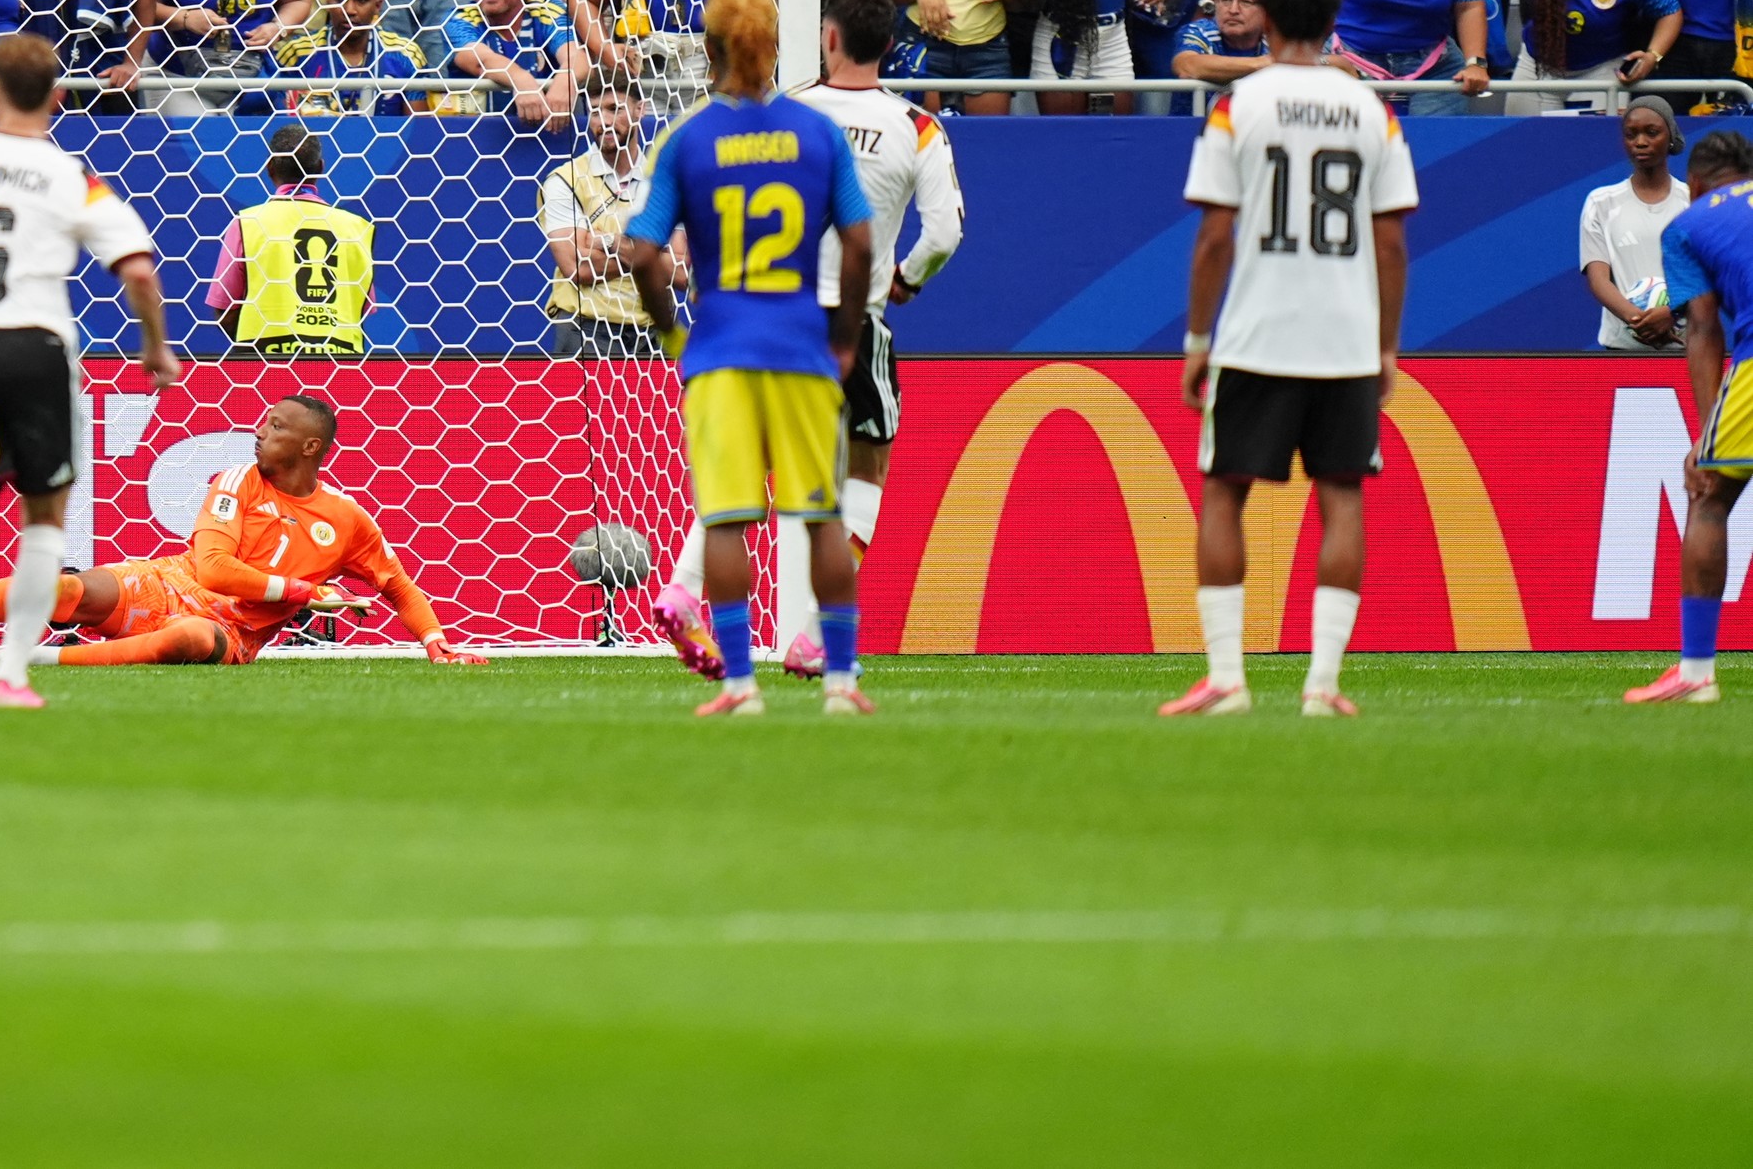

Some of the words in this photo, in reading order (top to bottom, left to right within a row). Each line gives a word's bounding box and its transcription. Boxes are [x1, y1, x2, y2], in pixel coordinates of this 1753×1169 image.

[1276, 99, 1361, 129] BROWN
[1260, 144, 1363, 257] 18
[711, 181, 806, 293] 12
[306, 288, 329, 298] FIFA
[296, 304, 324, 313] WORLD
[296, 314, 338, 327] 2026
[268, 533, 290, 568] 1
